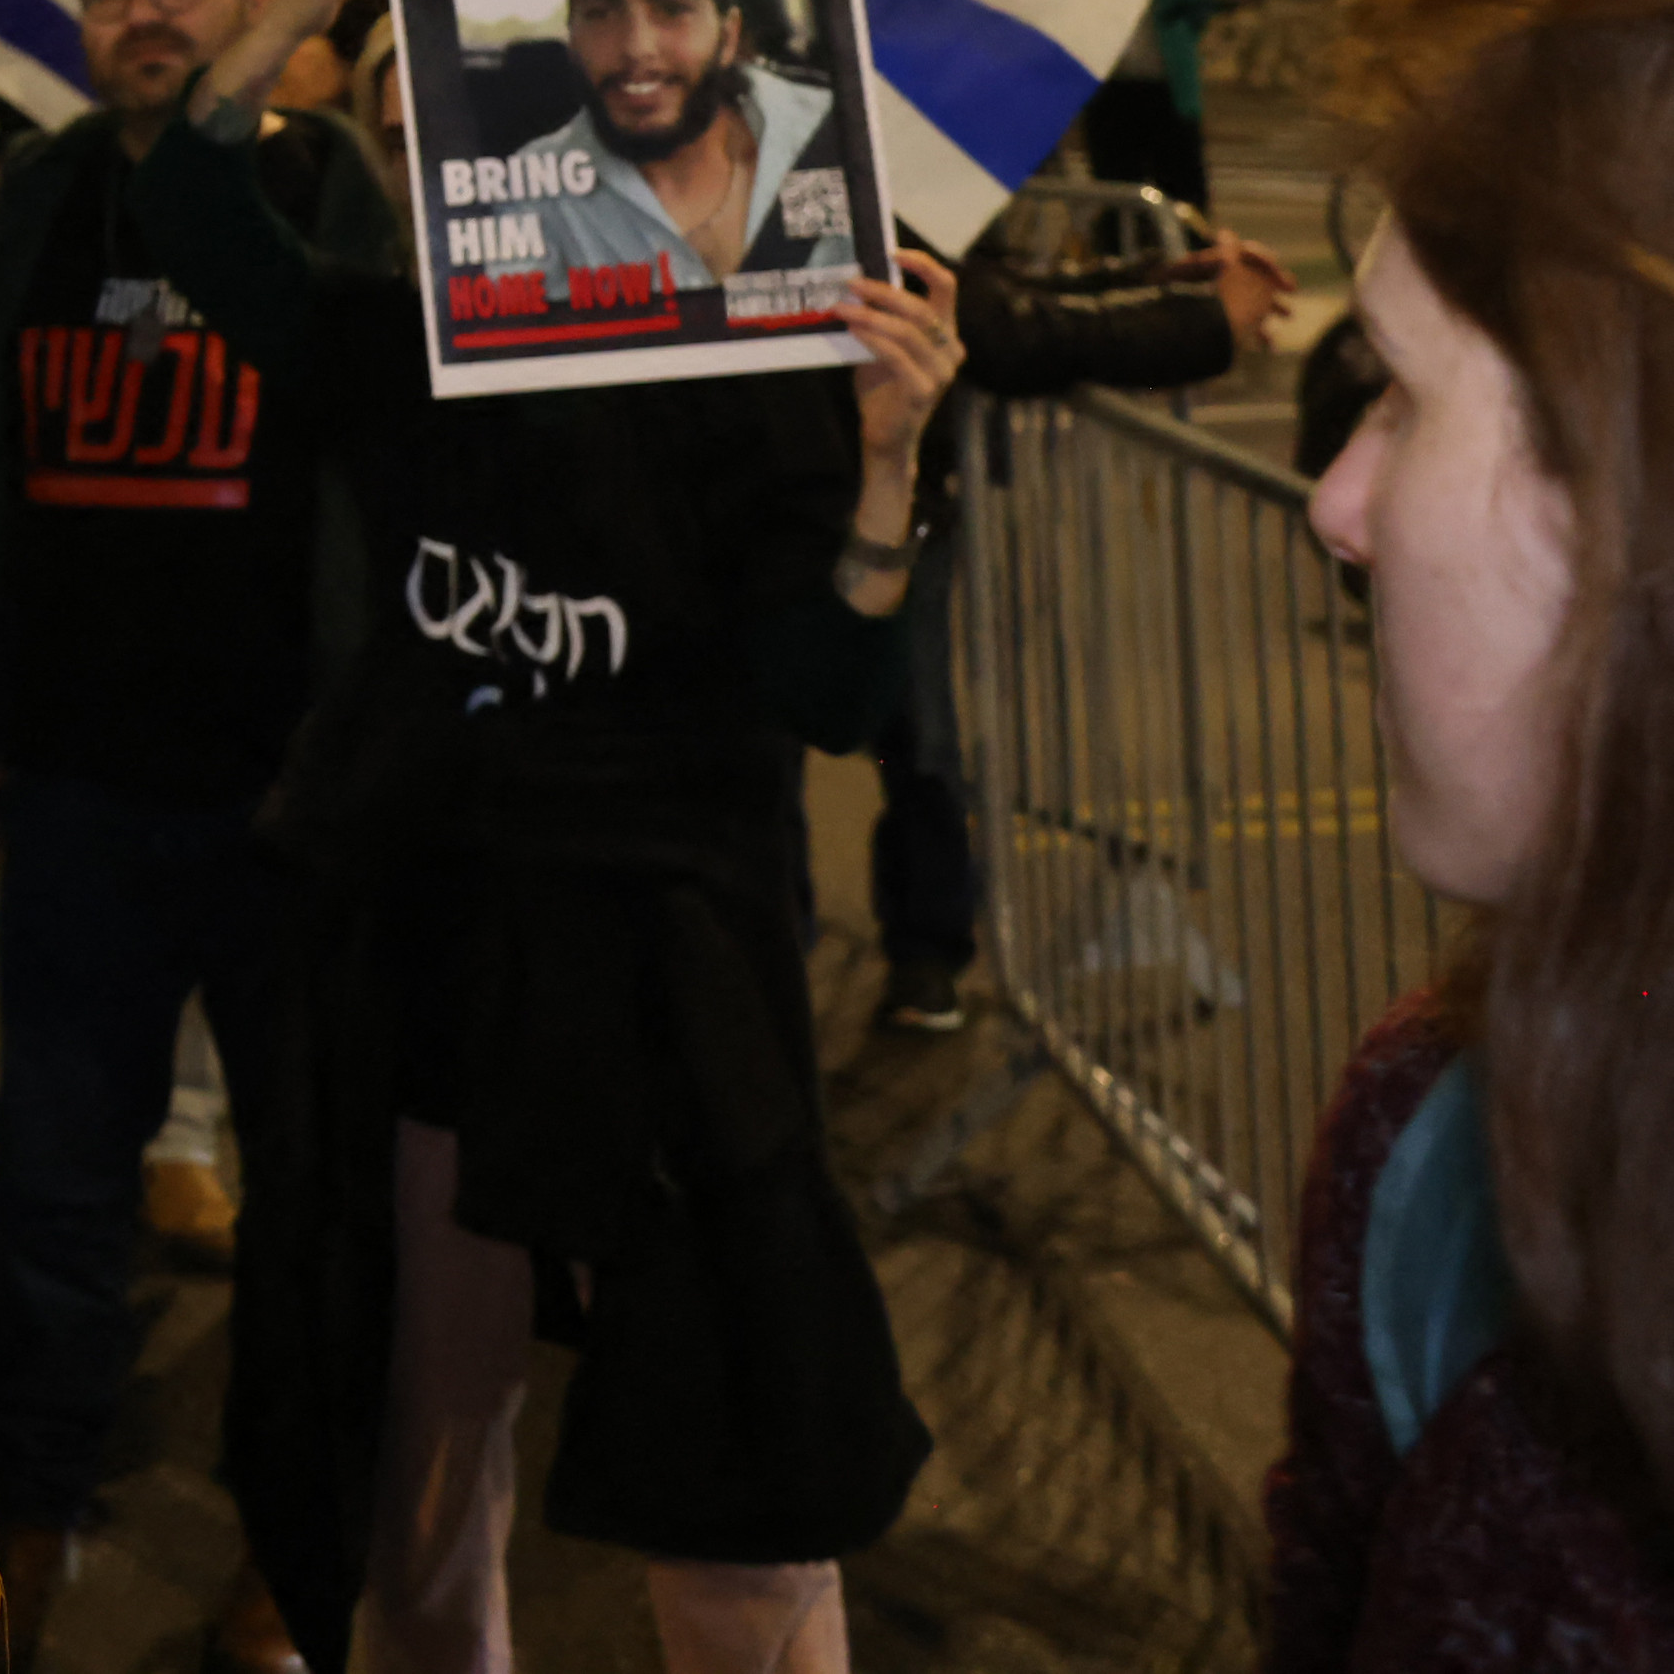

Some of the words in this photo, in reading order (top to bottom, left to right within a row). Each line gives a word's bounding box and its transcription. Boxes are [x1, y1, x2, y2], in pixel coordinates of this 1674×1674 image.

[440, 148, 597, 207] BRING
[447, 211, 546, 266] HIM
[448, 270, 549, 321] HOME
[19, 326, 261, 469] עכשיו
